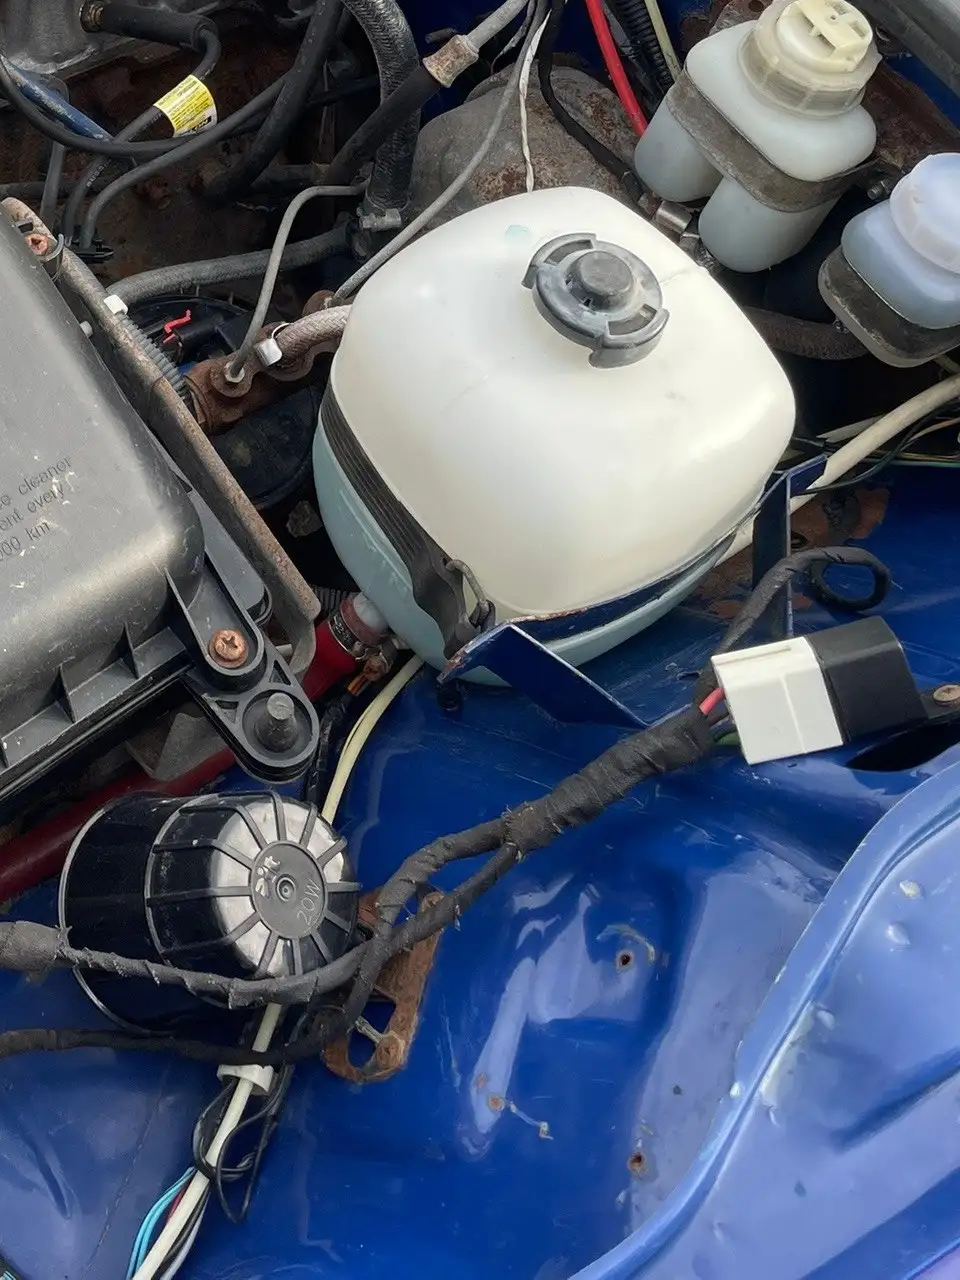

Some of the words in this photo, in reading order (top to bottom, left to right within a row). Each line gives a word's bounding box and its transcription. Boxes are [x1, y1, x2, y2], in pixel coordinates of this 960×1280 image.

[18, 457, 72, 496] cleaner
[27, 483, 65, 513] every
[24, 521, 51, 541] km
[296, 878, 321, 926] 20W
